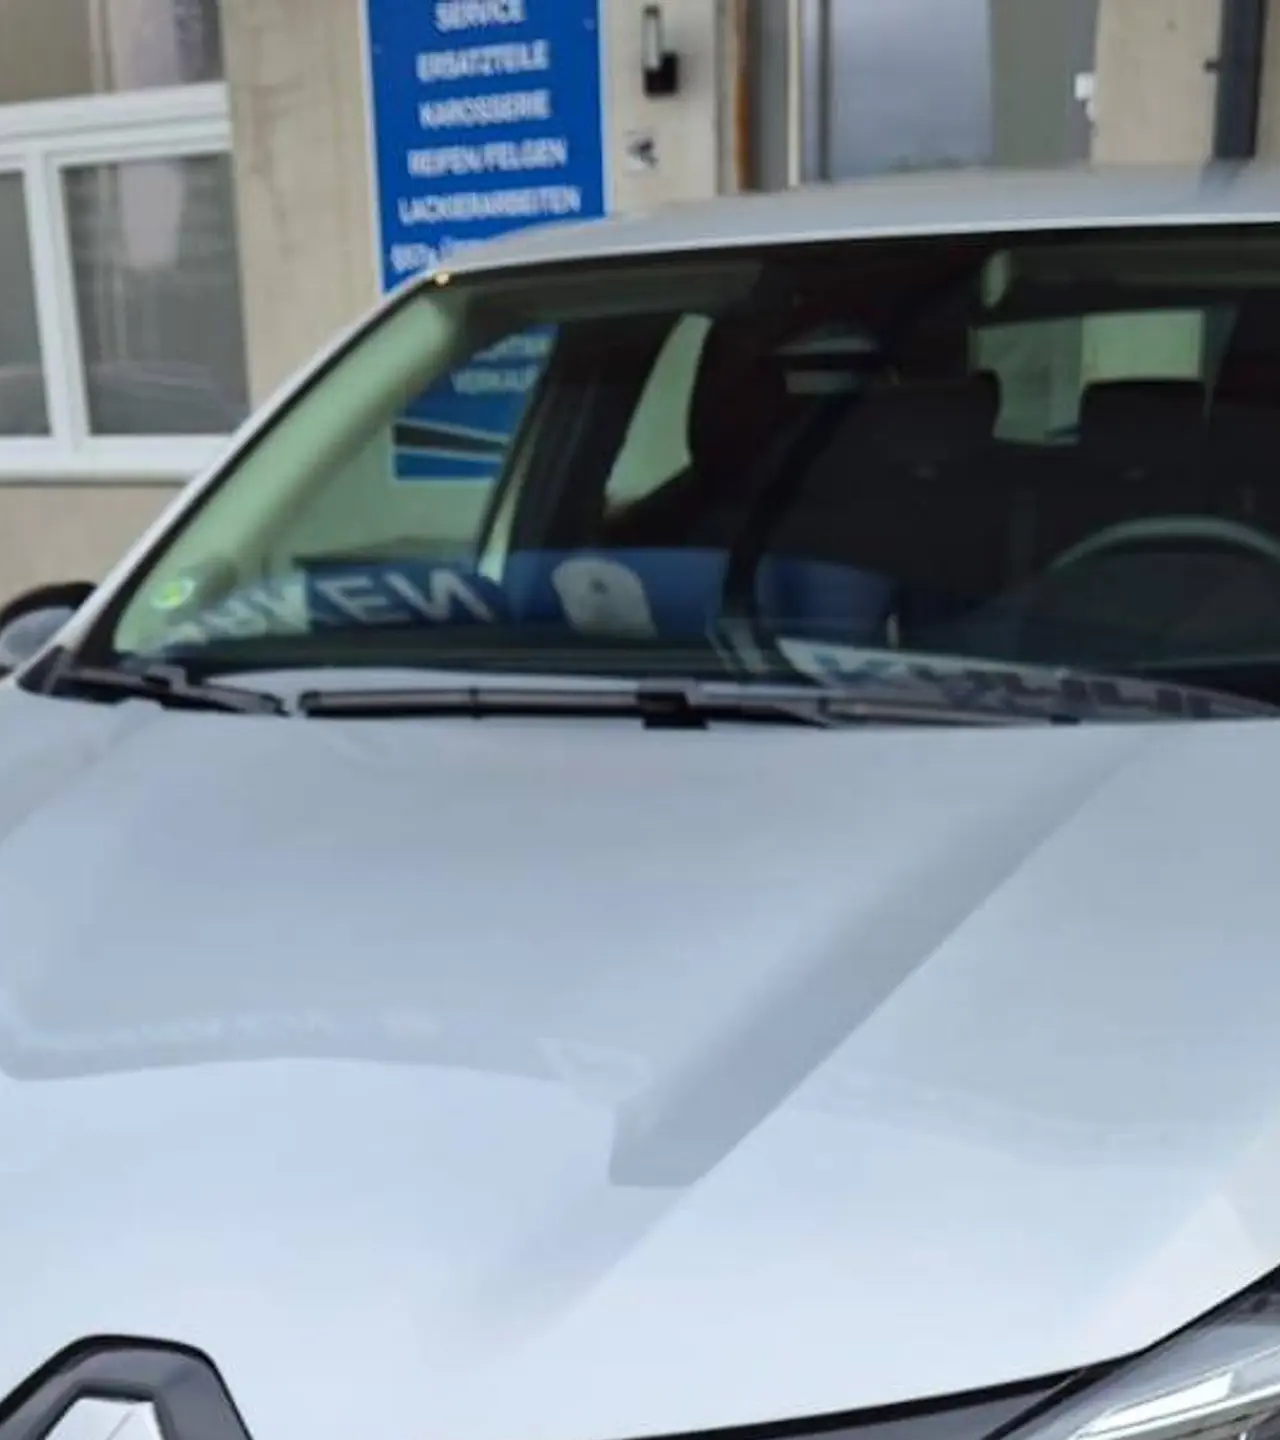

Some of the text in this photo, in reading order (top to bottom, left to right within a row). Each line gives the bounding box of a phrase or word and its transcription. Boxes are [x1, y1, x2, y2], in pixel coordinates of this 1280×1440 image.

[433, 0, 526, 32] SERVICE
[416, 39, 550, 82] ERSATZTEILE
[419, 89, 552, 130] KAROSSERIE
[397, 185, 582, 226] LACKIERARBEITEN
